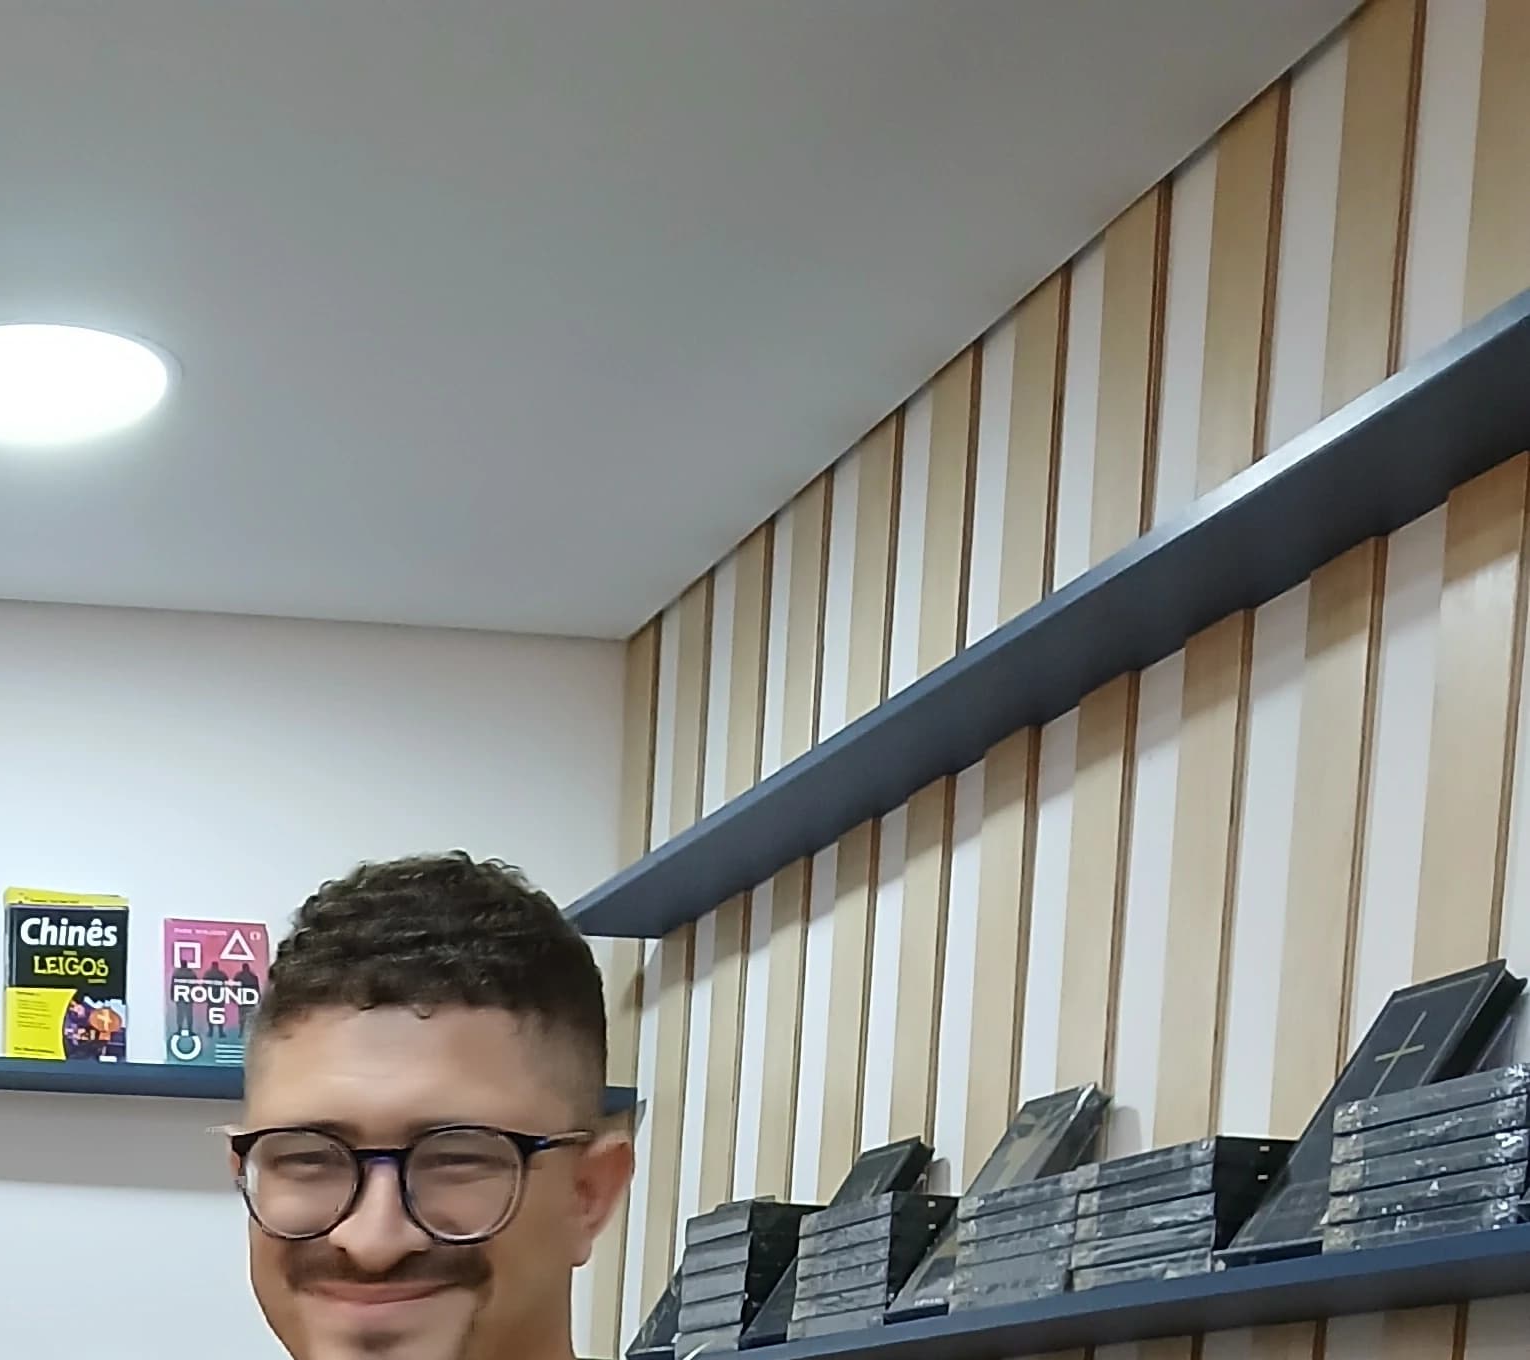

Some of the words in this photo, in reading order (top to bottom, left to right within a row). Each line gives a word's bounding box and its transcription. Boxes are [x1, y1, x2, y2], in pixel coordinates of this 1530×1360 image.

[20, 916, 118, 947] Chinês
[33, 955, 110, 977] LEIGOS
[173, 984, 260, 1005] ROUND
[208, 1007, 226, 1025] 6
